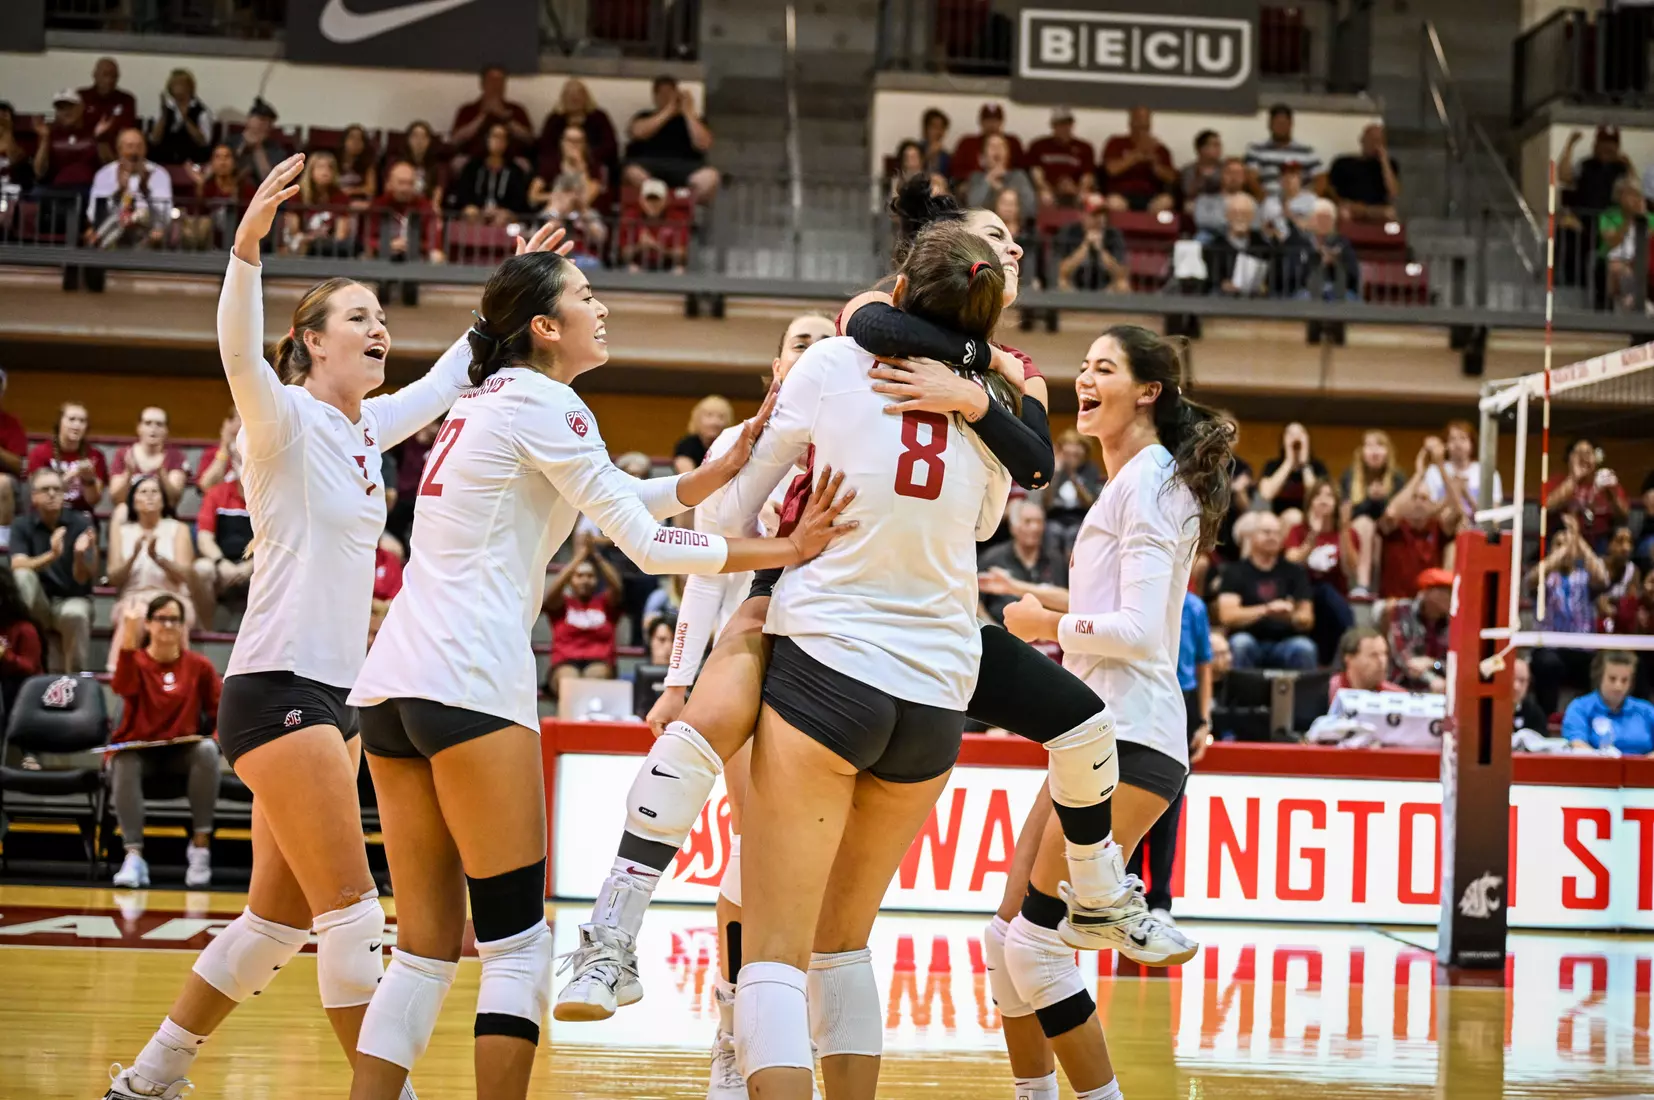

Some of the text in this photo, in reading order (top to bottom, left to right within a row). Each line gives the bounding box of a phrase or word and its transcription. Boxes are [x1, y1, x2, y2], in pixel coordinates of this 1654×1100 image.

[575, 424, 586, 433] 12
[894, 409, 949, 501] 8
[669, 622, 689, 670] COUGARS
